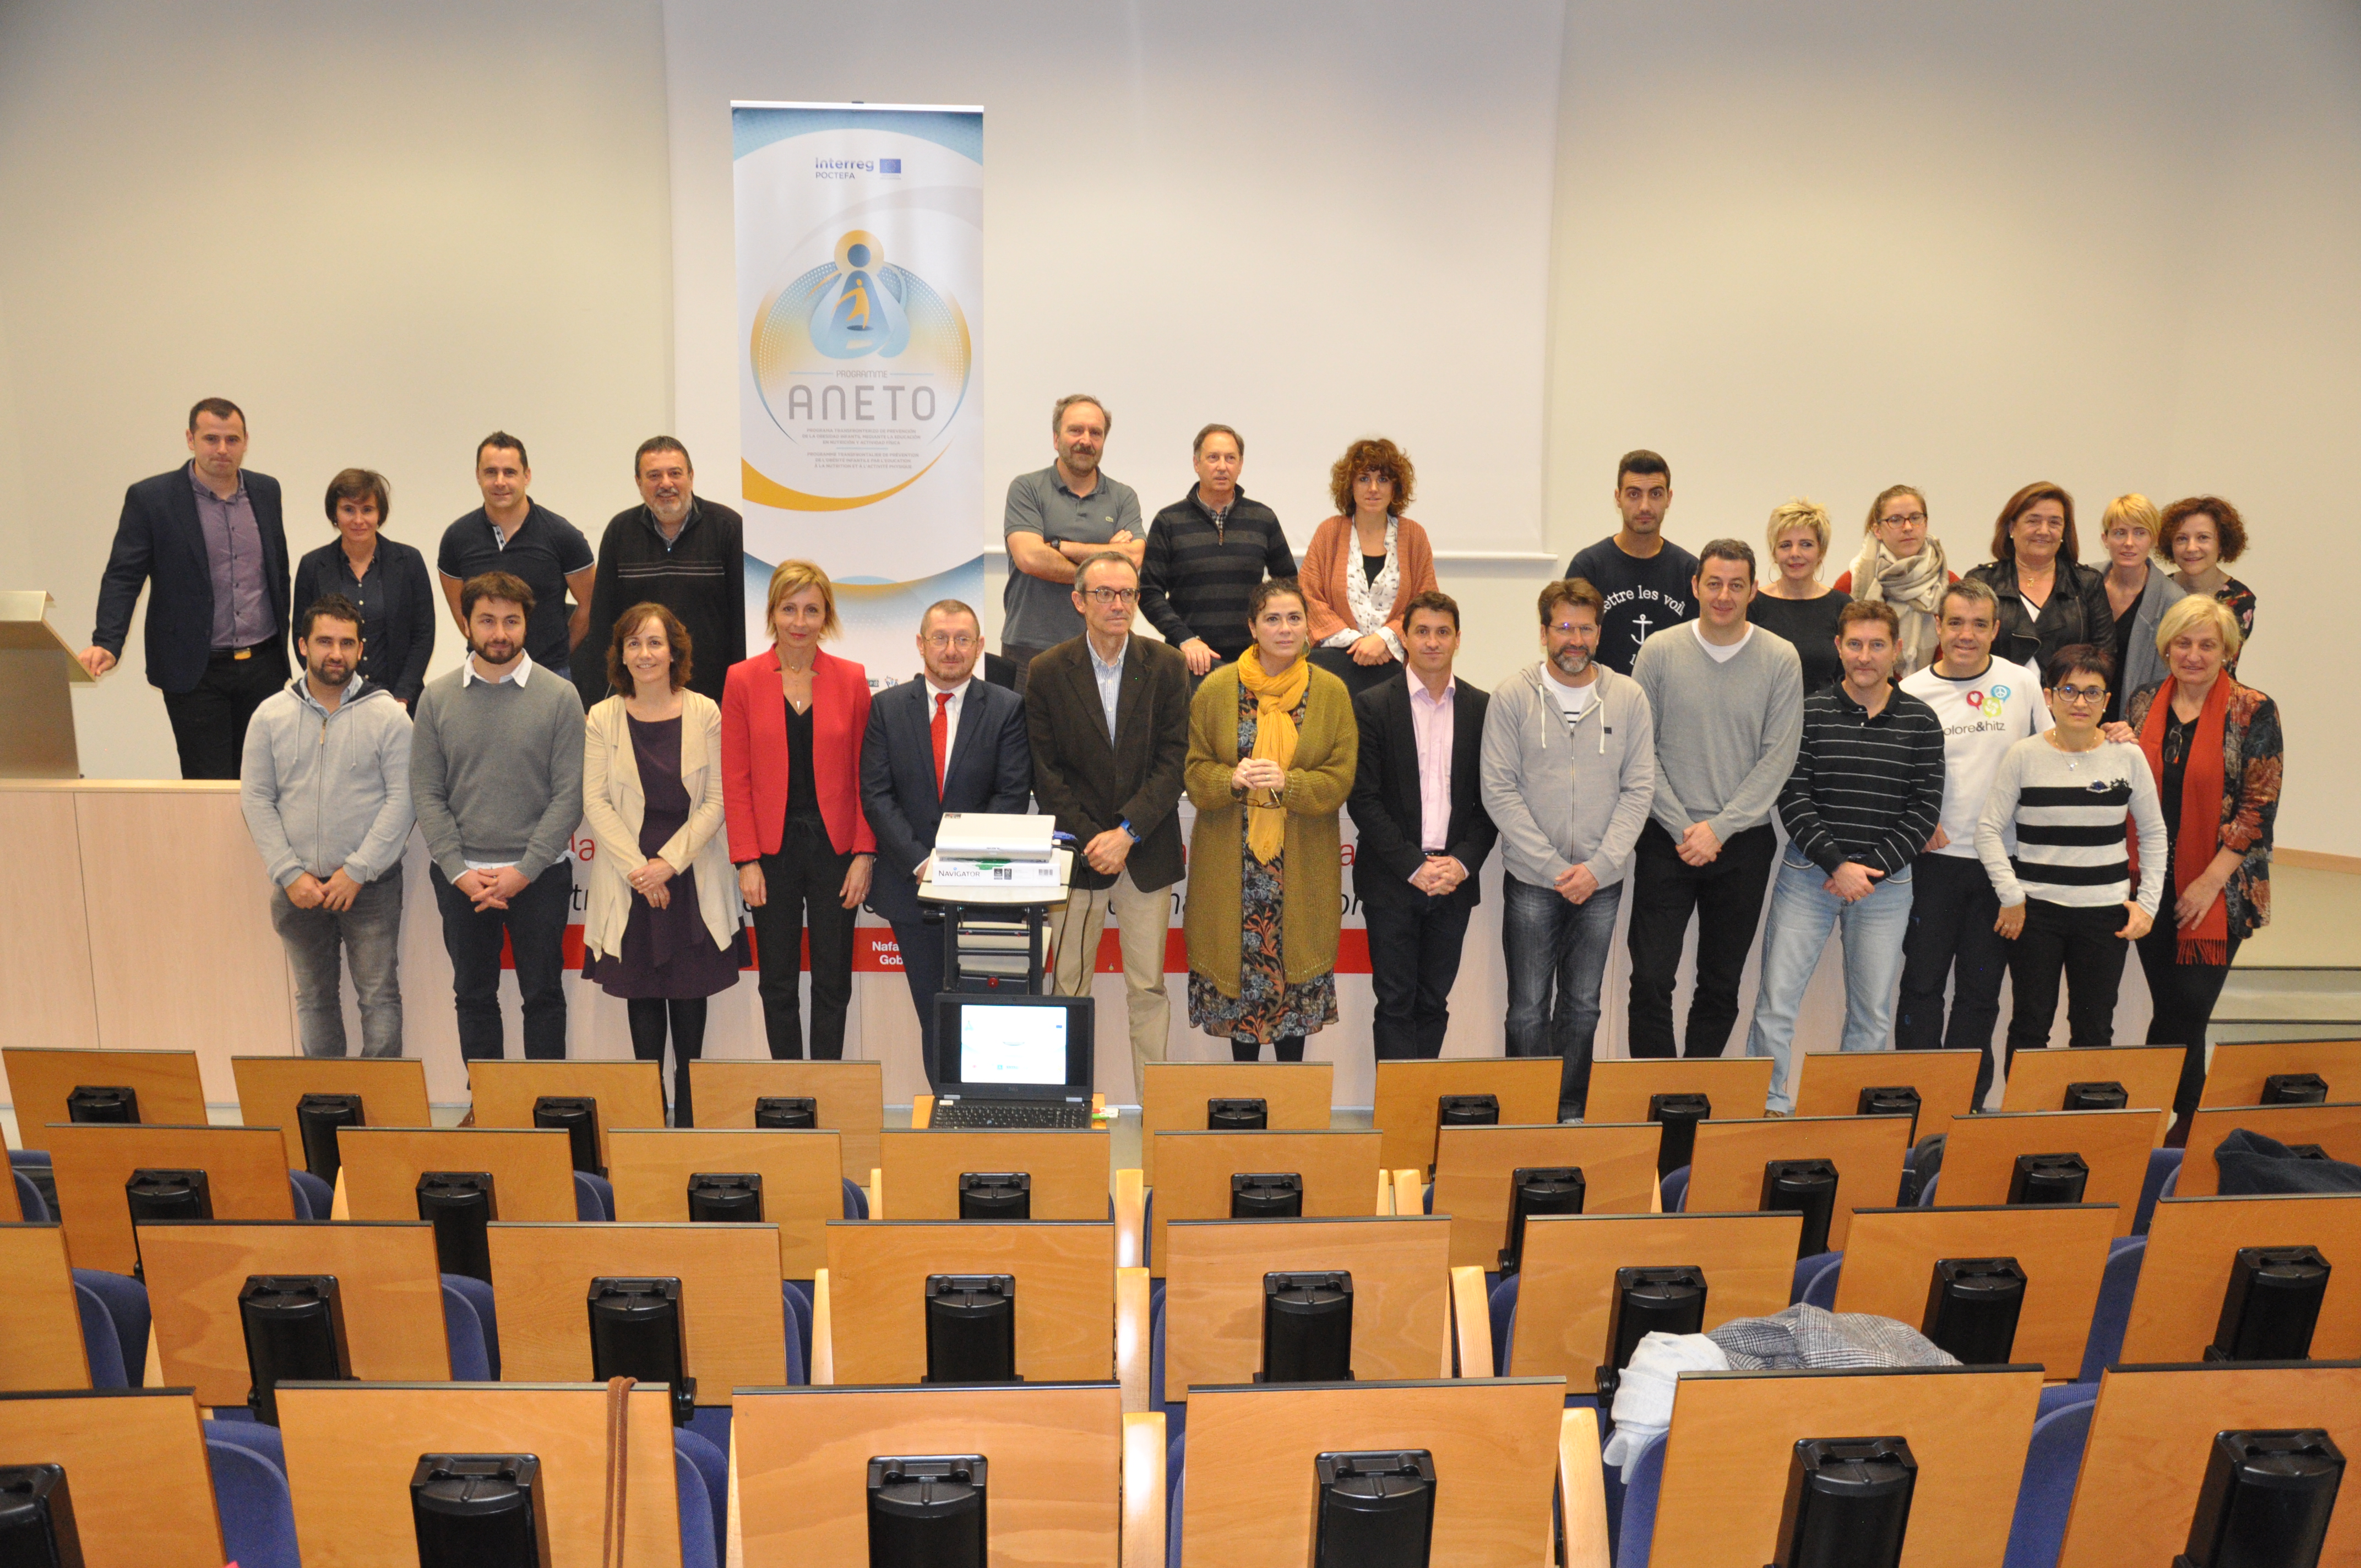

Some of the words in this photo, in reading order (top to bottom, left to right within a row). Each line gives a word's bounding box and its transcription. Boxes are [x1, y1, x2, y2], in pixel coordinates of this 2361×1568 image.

[815, 157, 874, 171] Interreg
[788, 384, 935, 421] ANETO
[1604, 590, 1634, 613] ettre
[1638, 585, 1659, 600] les
[939, 868, 980, 877] NAVIGATOR
